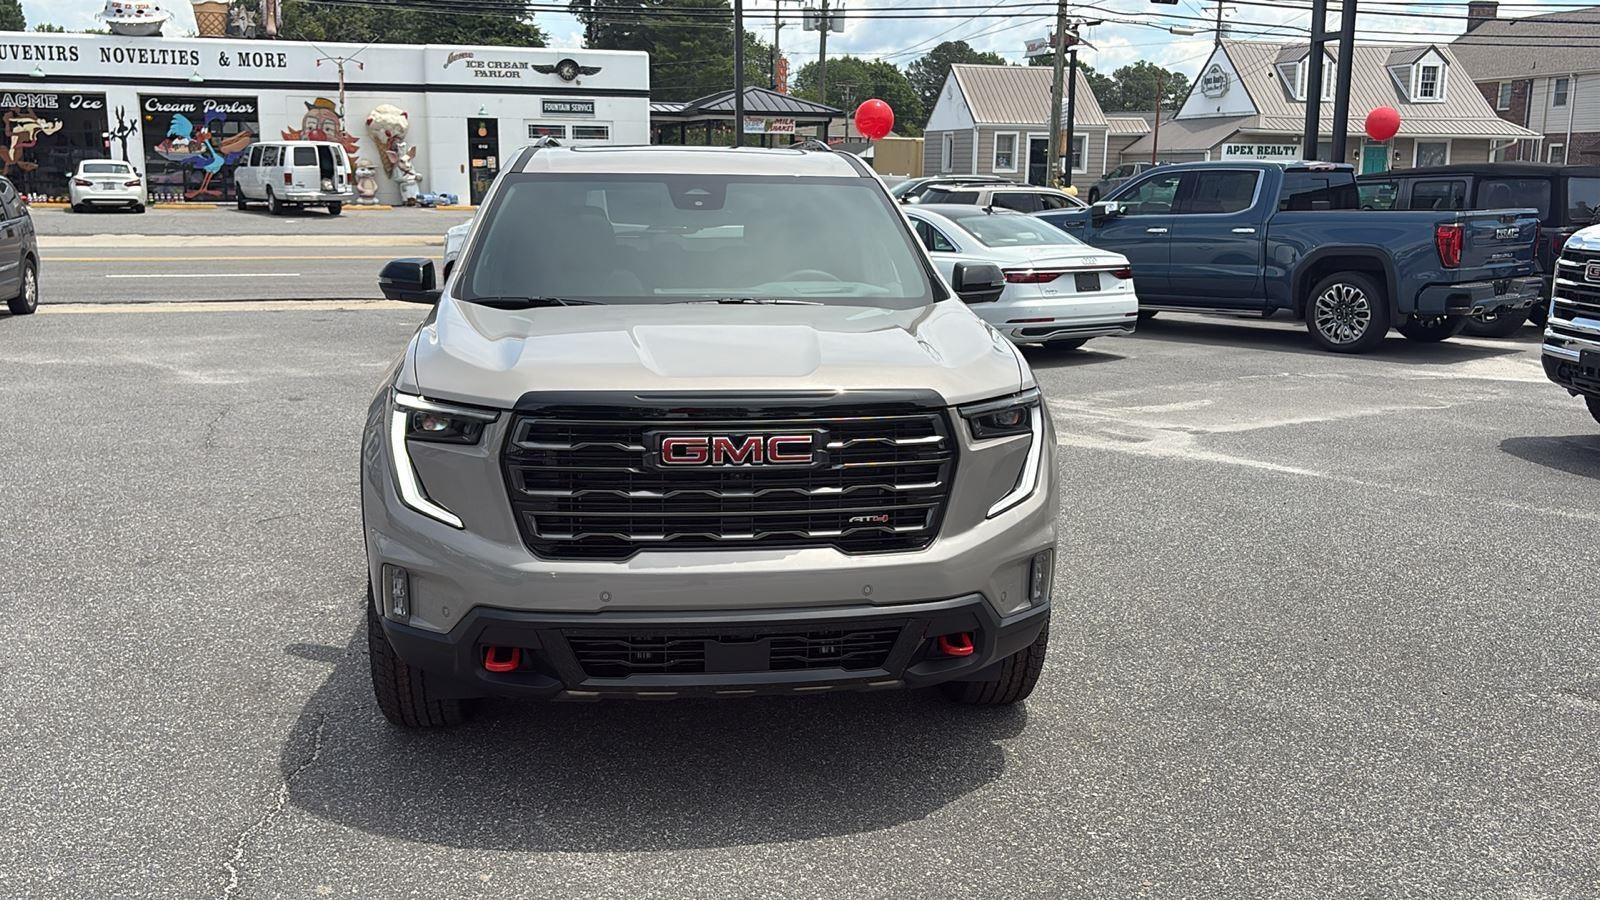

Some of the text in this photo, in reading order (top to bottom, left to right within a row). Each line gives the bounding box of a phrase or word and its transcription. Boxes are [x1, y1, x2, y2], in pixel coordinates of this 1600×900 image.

[99, 47, 200, 66] NOVELTIES
[218, 51, 231, 67] &
[237, 52, 287, 68] MORE
[465, 60, 528, 70] ICE CREAM
[474, 70, 521, 79] PARLOR
[1, 93, 103, 109] ACME Ice
[144, 97, 255, 113] Cream Parlor
[544, 103, 594, 112] FOUNTAIN SERVICE
[1226, 145, 1297, 155] APEX REALTY
[662, 435, 813, 465] GMC
[849, 514, 889, 524] AT4
